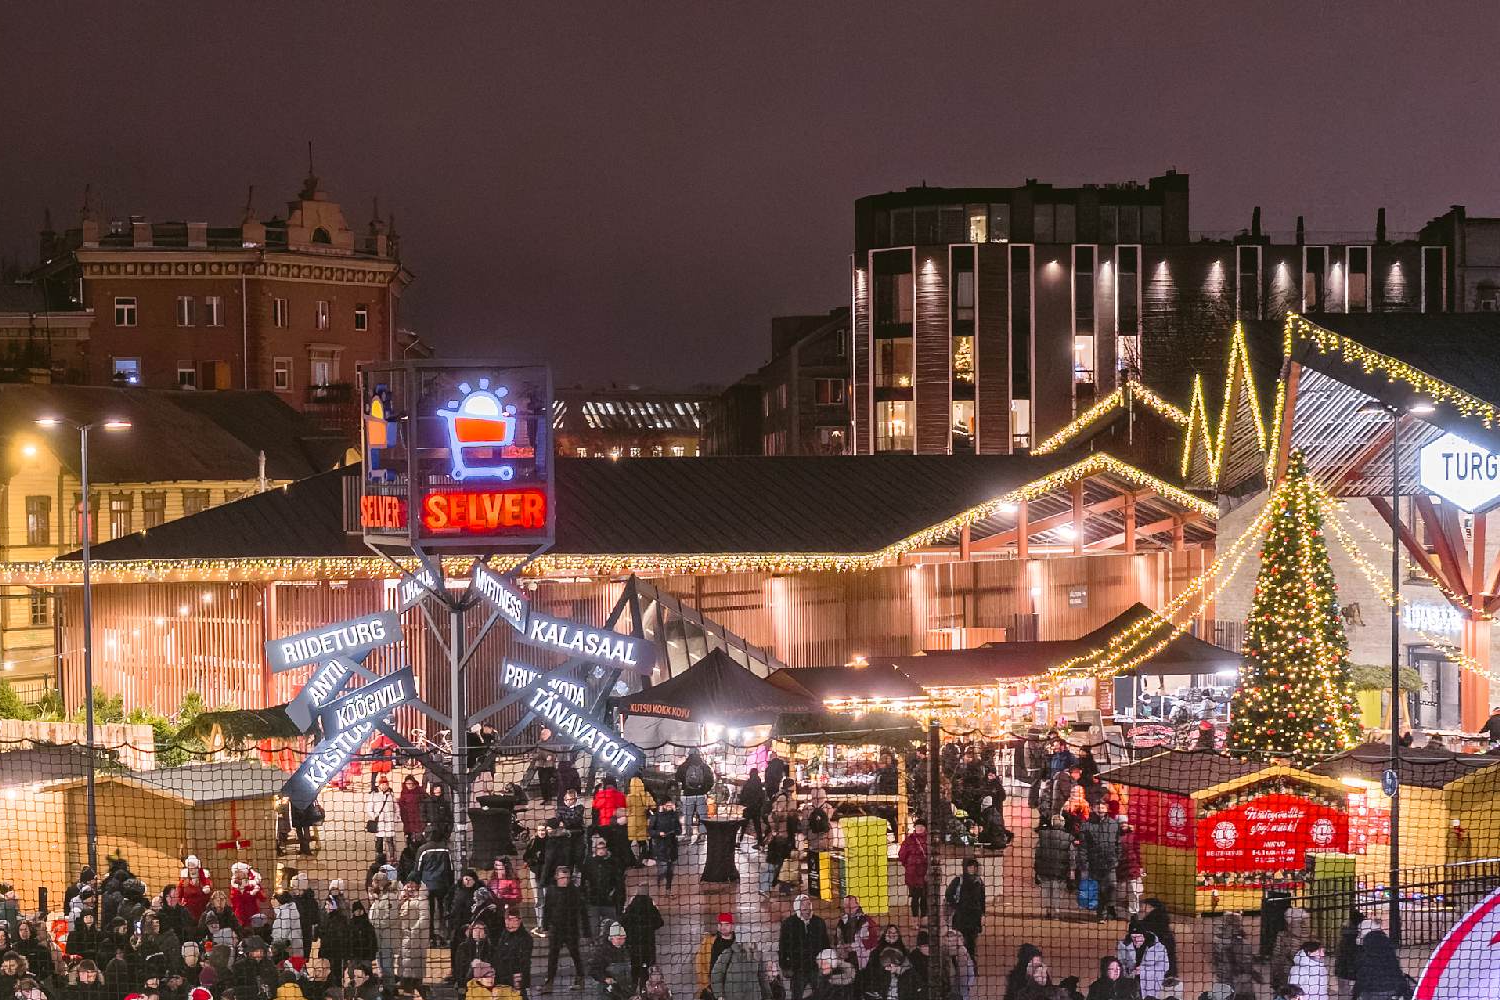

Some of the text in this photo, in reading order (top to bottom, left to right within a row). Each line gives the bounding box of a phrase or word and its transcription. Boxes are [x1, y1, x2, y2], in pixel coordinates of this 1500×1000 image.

[1442, 452, 1497, 480] TURG
[360, 495, 400, 528] SELVER
[426, 493, 546, 529] SELVER
[475, 566, 522, 622] MYFITNESS
[281, 619, 386, 664] RIIDETURG
[530, 619, 638, 665] KALASAAL
[529, 687, 637, 773] TÄNAVATOIT
